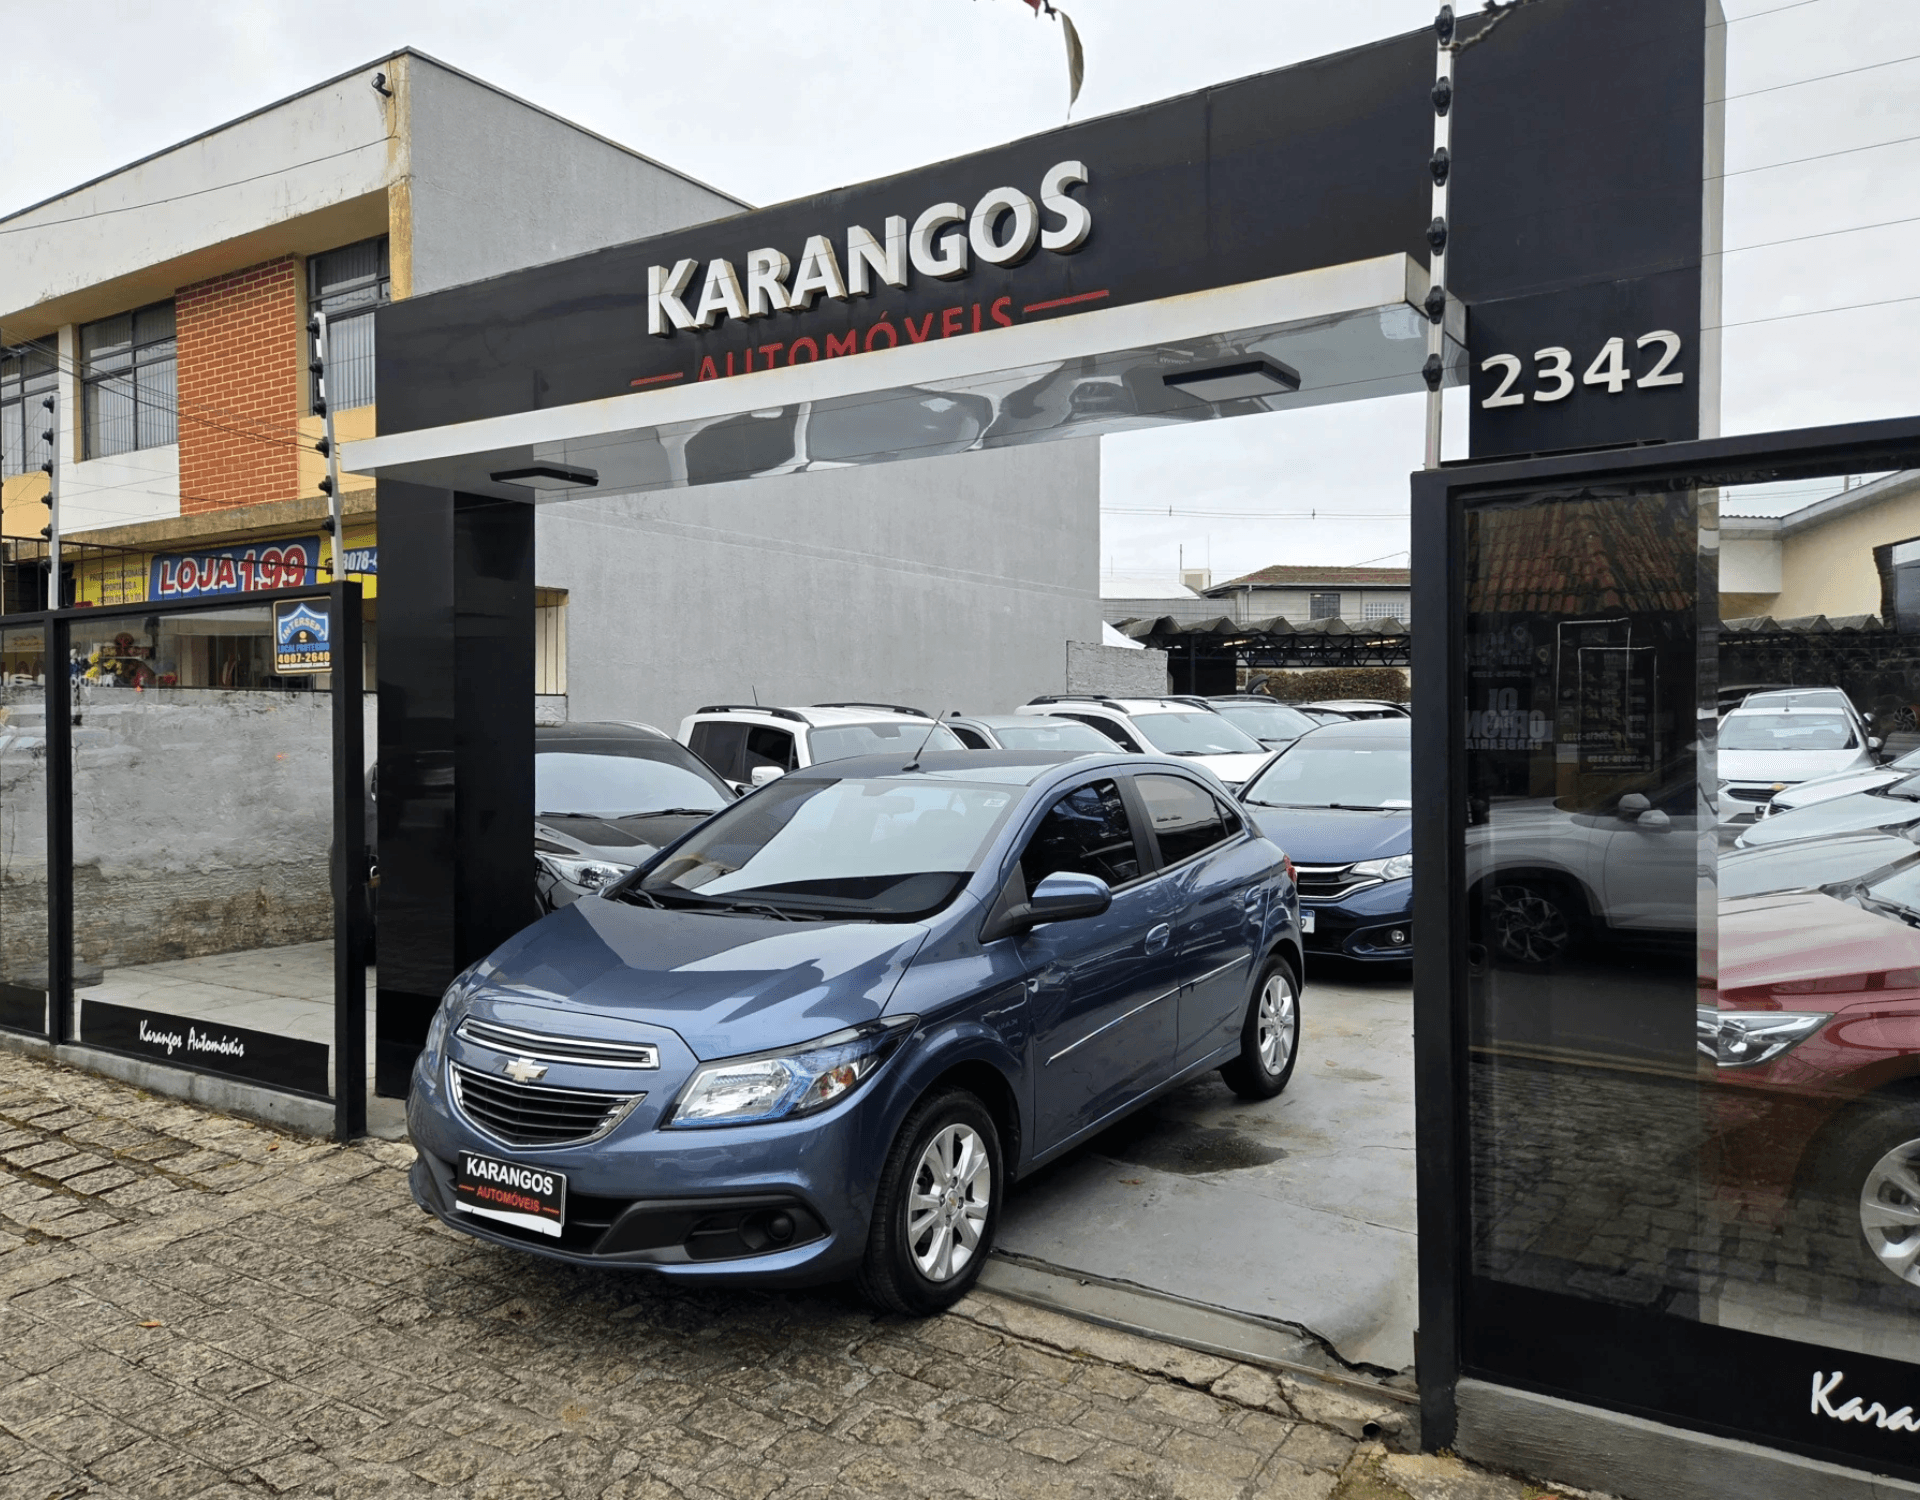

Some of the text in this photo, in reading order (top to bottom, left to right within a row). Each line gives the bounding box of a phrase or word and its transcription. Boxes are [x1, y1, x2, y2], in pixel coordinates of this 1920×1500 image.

[647, 159, 1092, 338] KARANGOS
[1481, 329, 1684, 409] 2342
[158, 553, 237, 595] LOJA
[282, 617, 325, 640] INTERSEPT
[278, 651, 330, 664] 4007-2640
[140, 1019, 182, 1055] Karangos
[466, 1157, 553, 1196] KARANGOS
[476, 1185, 540, 1212] AUTOMÓVEIS
